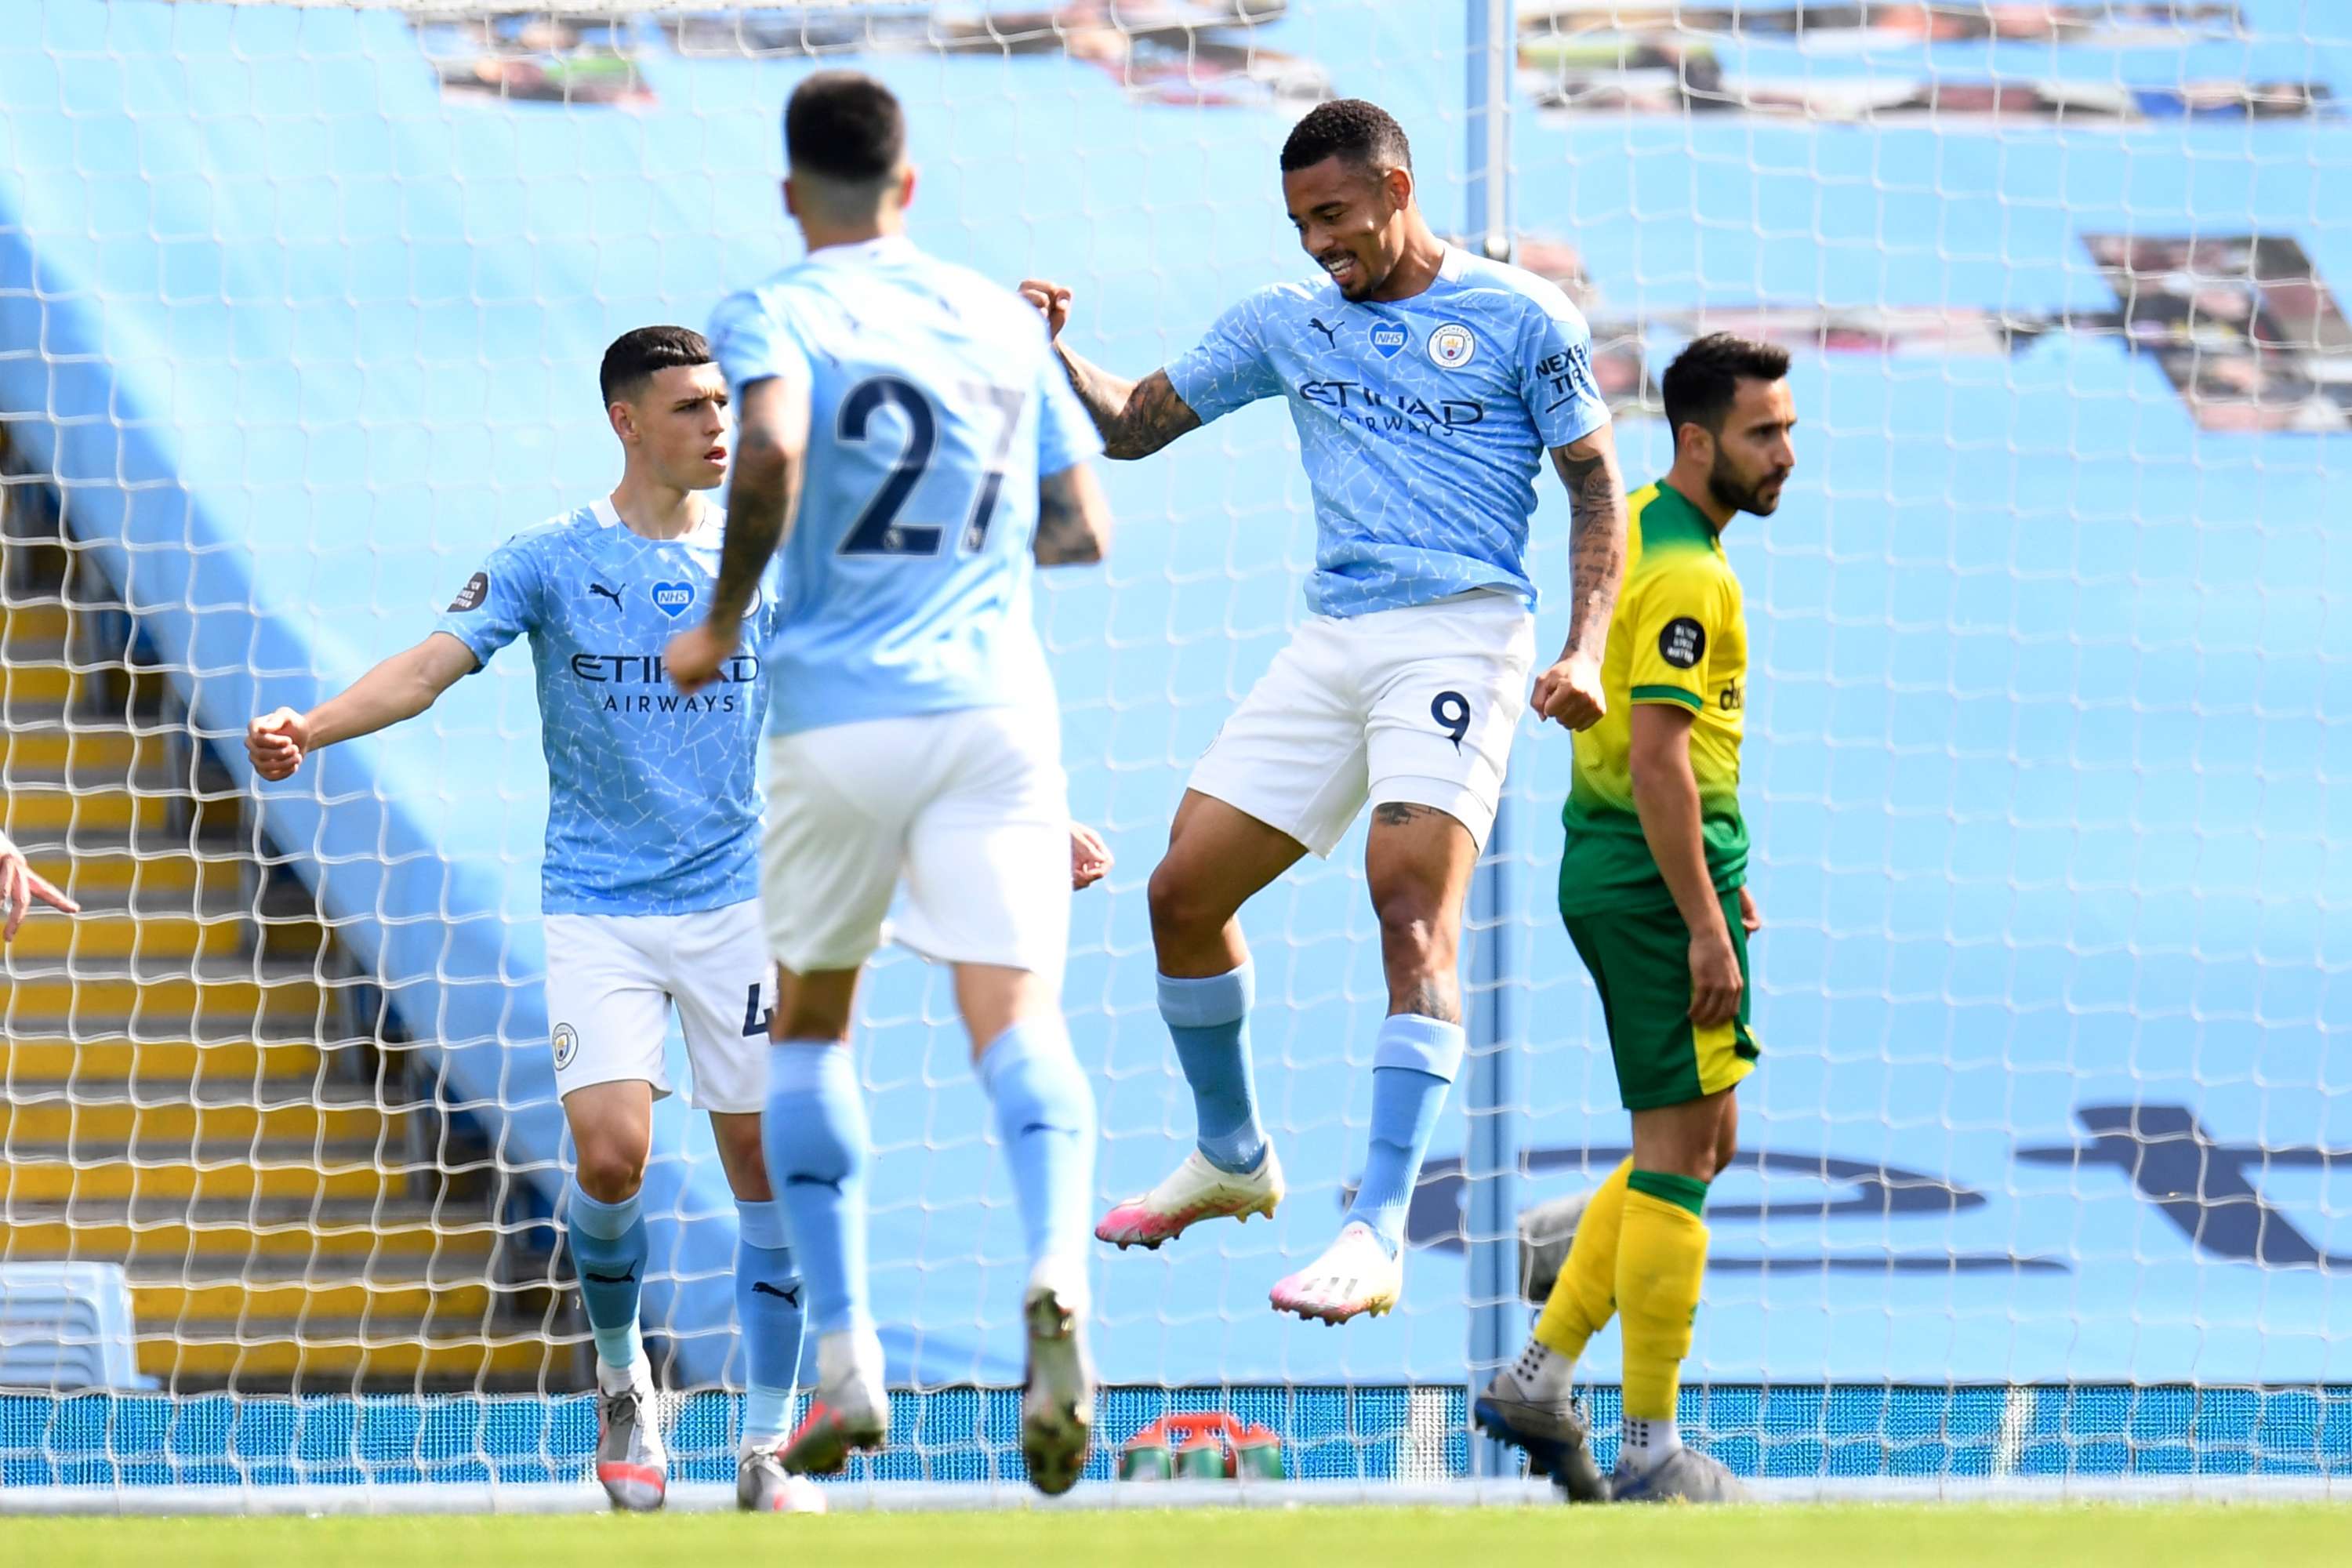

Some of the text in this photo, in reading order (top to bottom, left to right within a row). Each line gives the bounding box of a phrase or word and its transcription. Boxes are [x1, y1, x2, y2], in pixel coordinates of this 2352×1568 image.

[1377, 333, 1402, 343] NHS
[1549, 368, 1588, 394] TIR
[836, 376, 1025, 555] 27
[659, 591, 689, 604] NHS
[571, 653, 759, 684] ETID
[603, 695, 734, 713] AIRWAYS
[1431, 691, 1471, 757] 9
[742, 982, 771, 1037] 4
